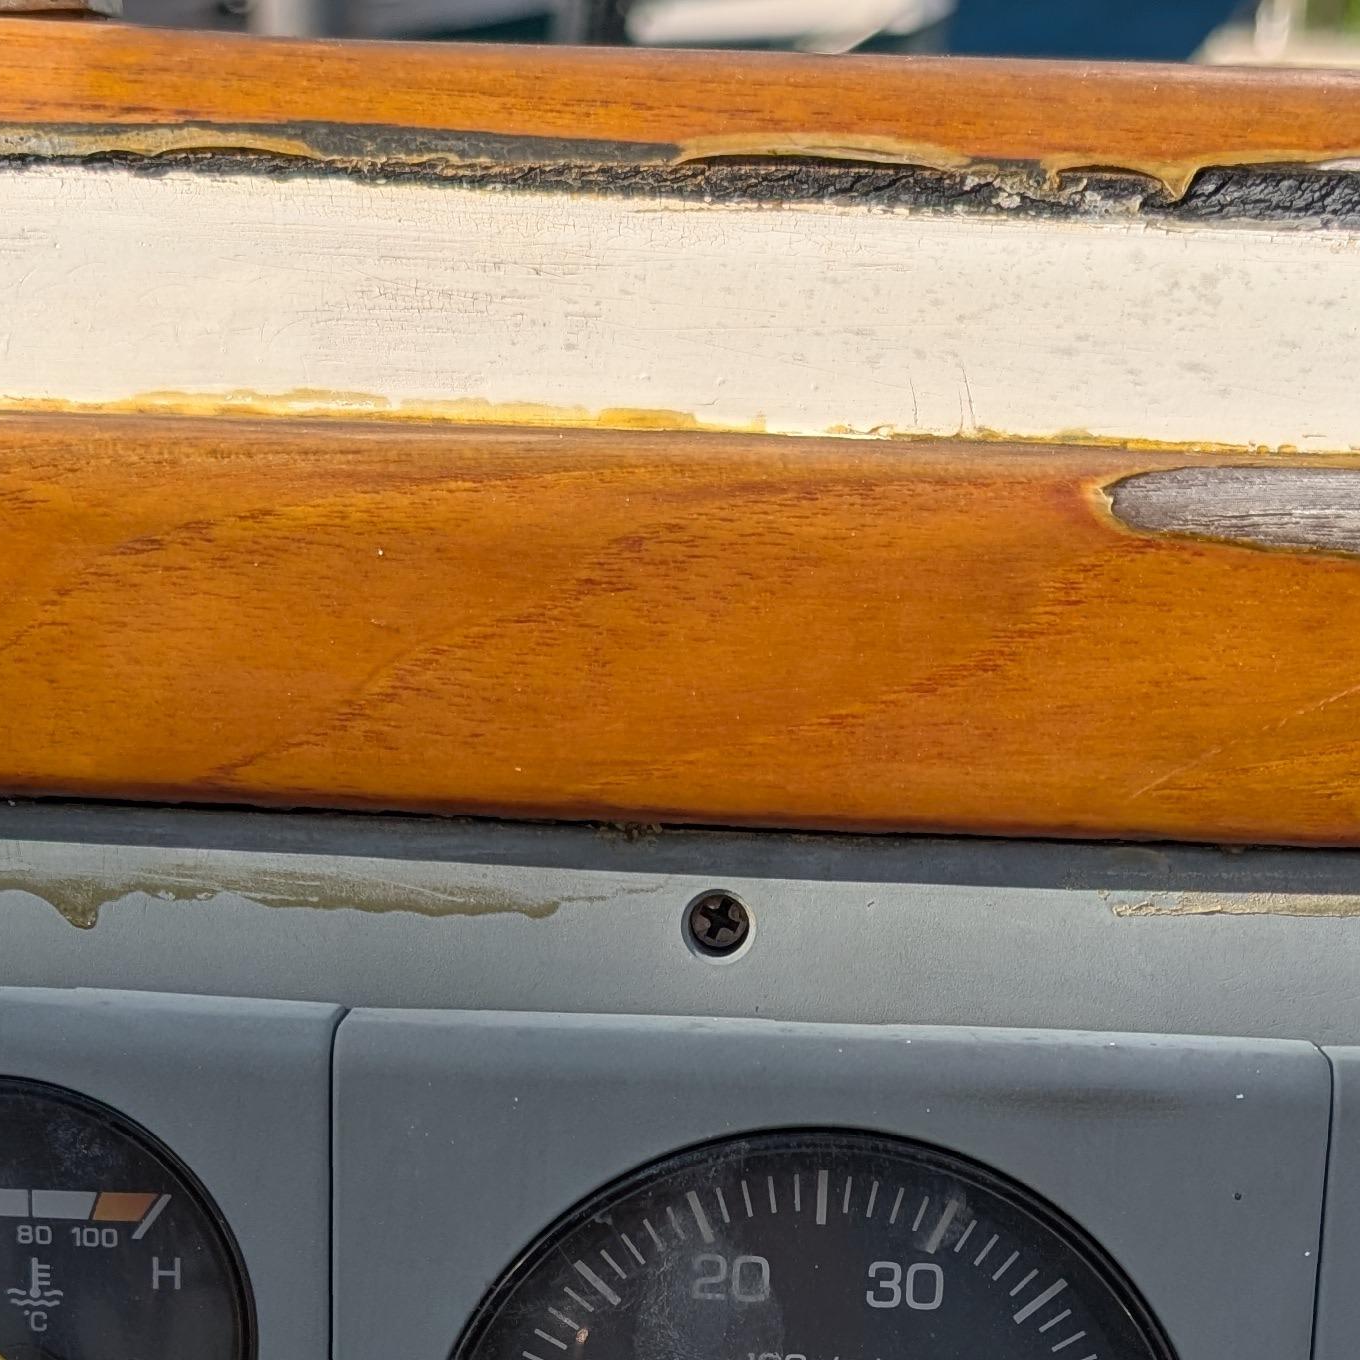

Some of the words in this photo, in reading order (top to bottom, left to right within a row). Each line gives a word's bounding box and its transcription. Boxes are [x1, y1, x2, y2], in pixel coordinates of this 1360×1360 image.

[17, 1225, 52, 1245] 80
[71, 1227, 118, 1248] 100
[153, 1257, 182, 1290] H
[690, 1256, 771, 1302] 20
[866, 1263, 944, 1311] 30
